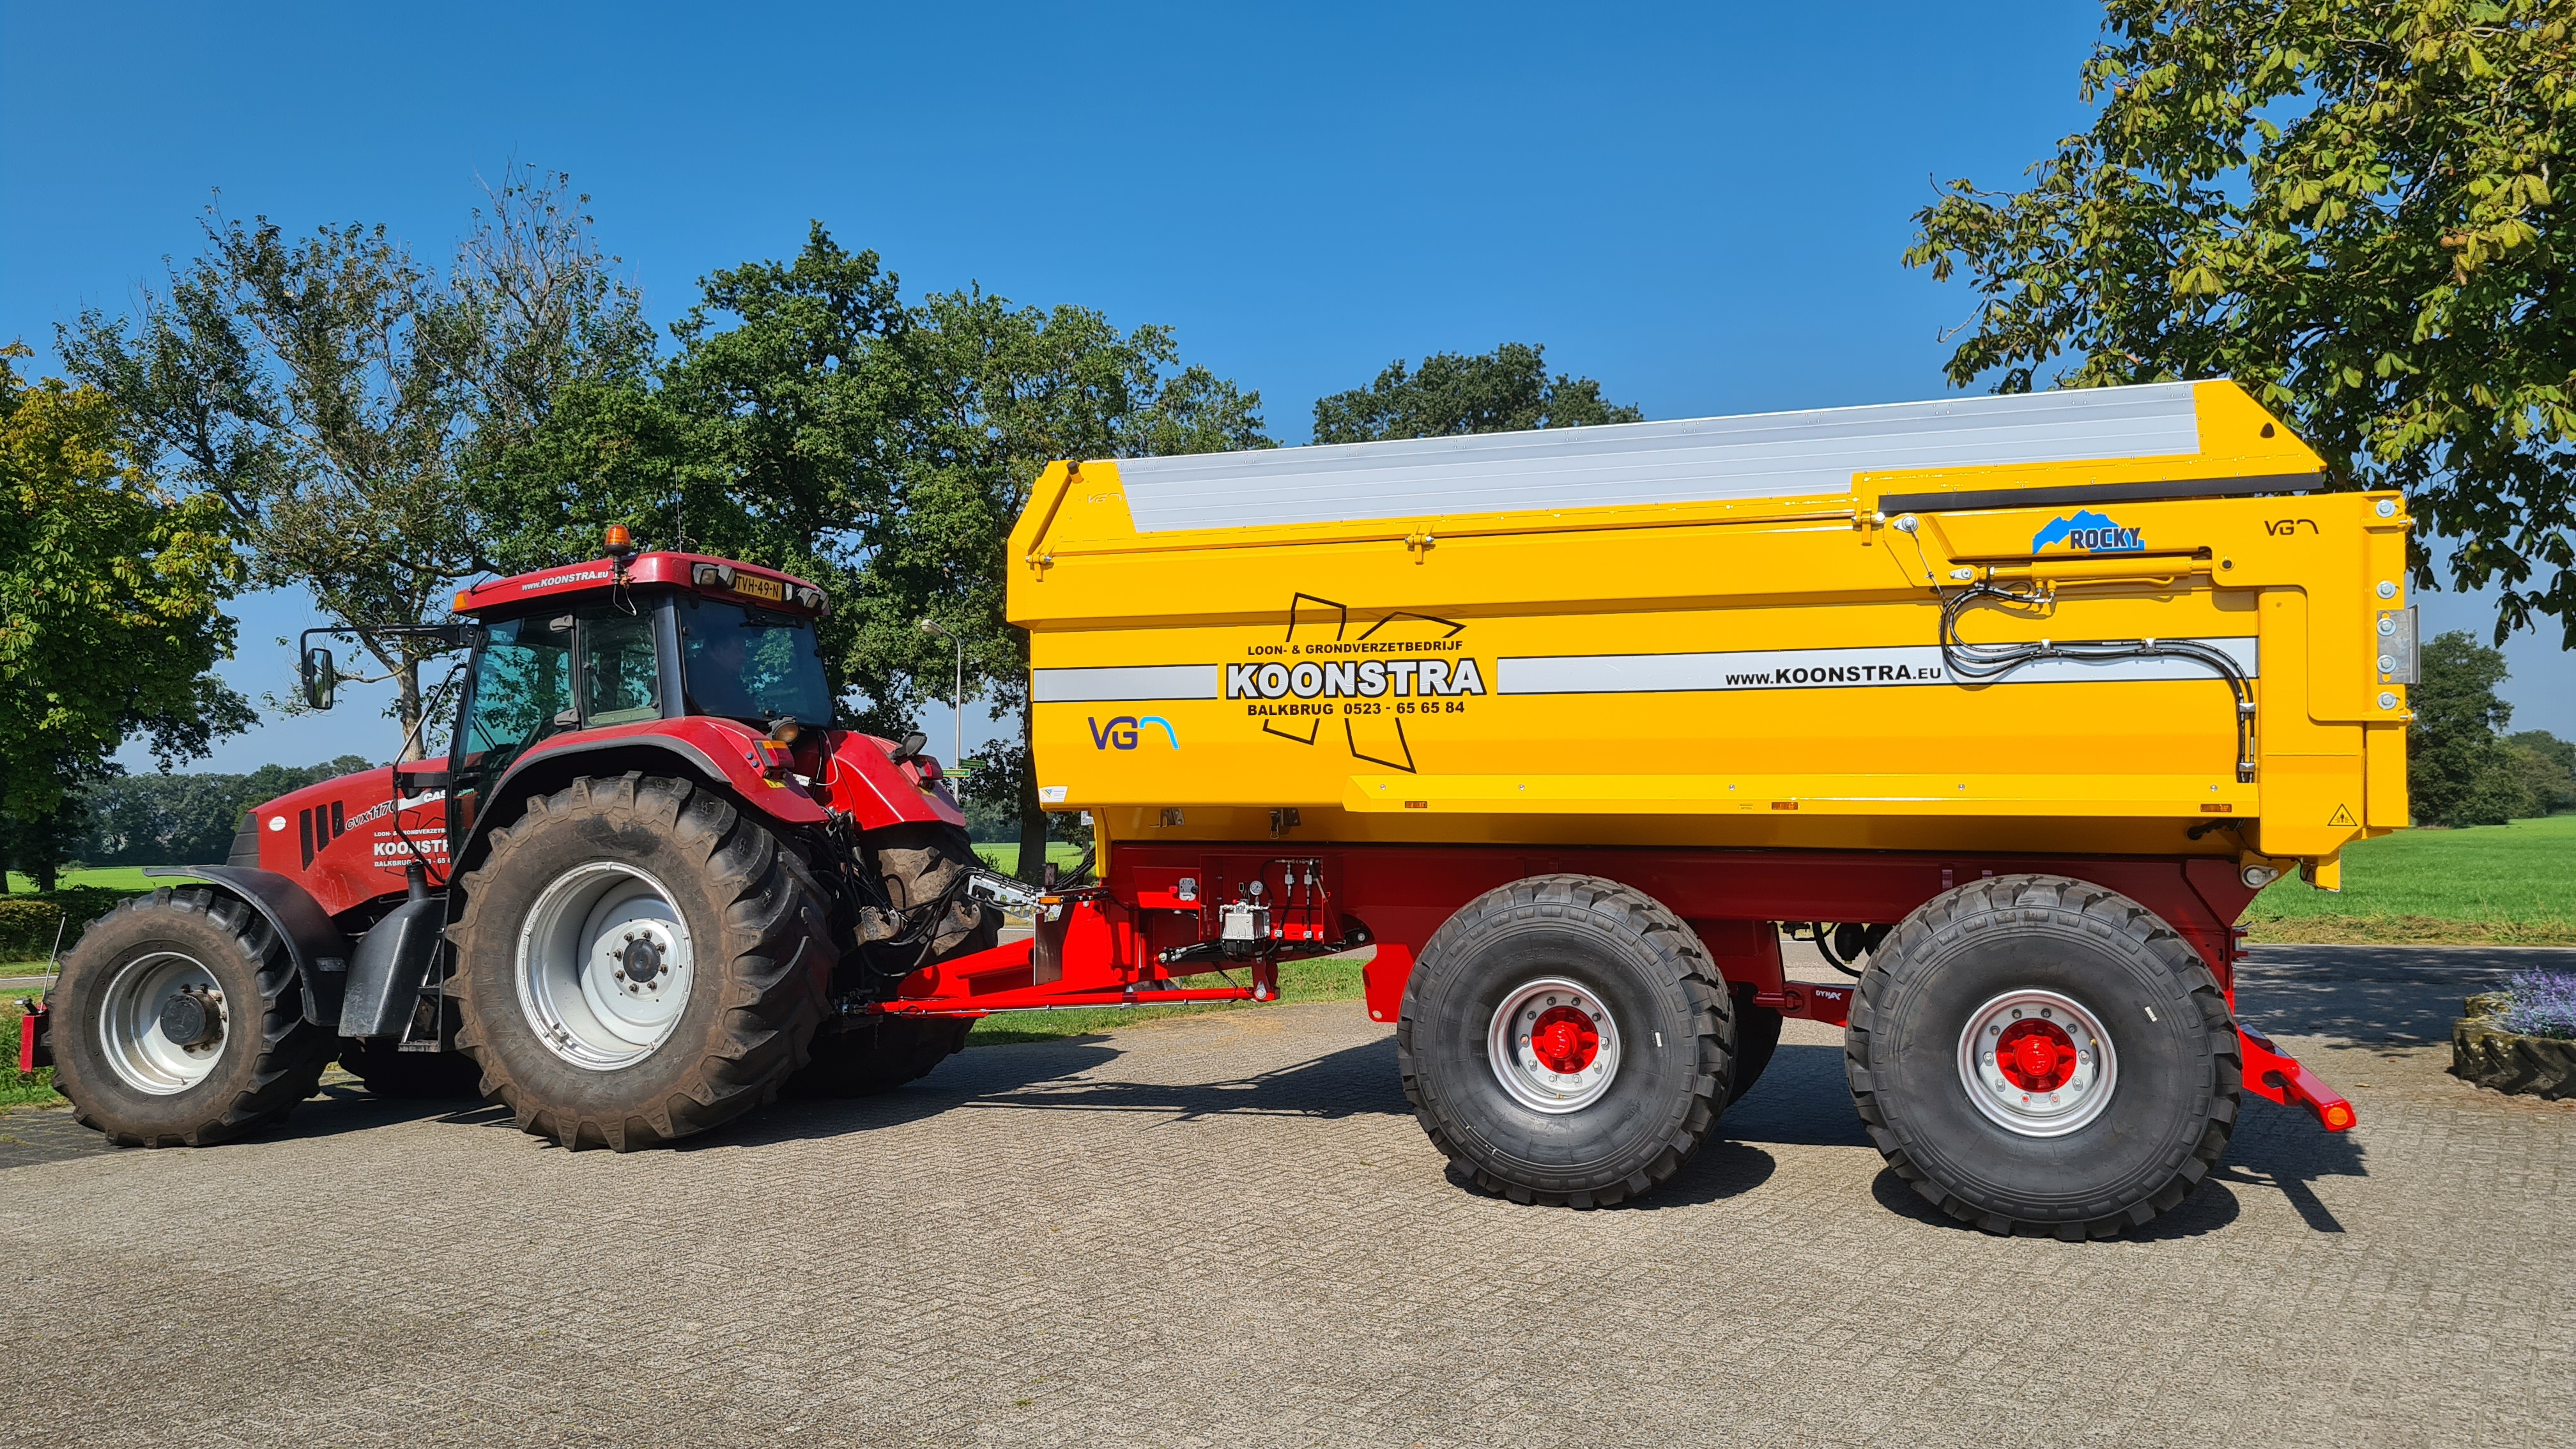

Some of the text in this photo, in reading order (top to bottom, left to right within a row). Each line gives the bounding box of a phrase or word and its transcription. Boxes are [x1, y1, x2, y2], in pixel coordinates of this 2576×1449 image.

[2070, 527, 2142, 549] ROCKY
[521, 571, 609, 591] www.KOONSTRA.EU
[737, 576, 779, 597] TVH-49-N
[1248, 640, 1463, 656] LOON- & GRONDVERZETBEDRIJF
[1226, 657, 1487, 700] KOONSTRA
[1726, 664, 1942, 686] www.KOONSTRA.EU
[1247, 704, 1333, 716] BALKBRUG
[1344, 703, 1381, 715] 0523
[1396, 702, 1415, 714] 65
[1421, 702, 1440, 714] 65
[1445, 702, 1465, 713] 84
